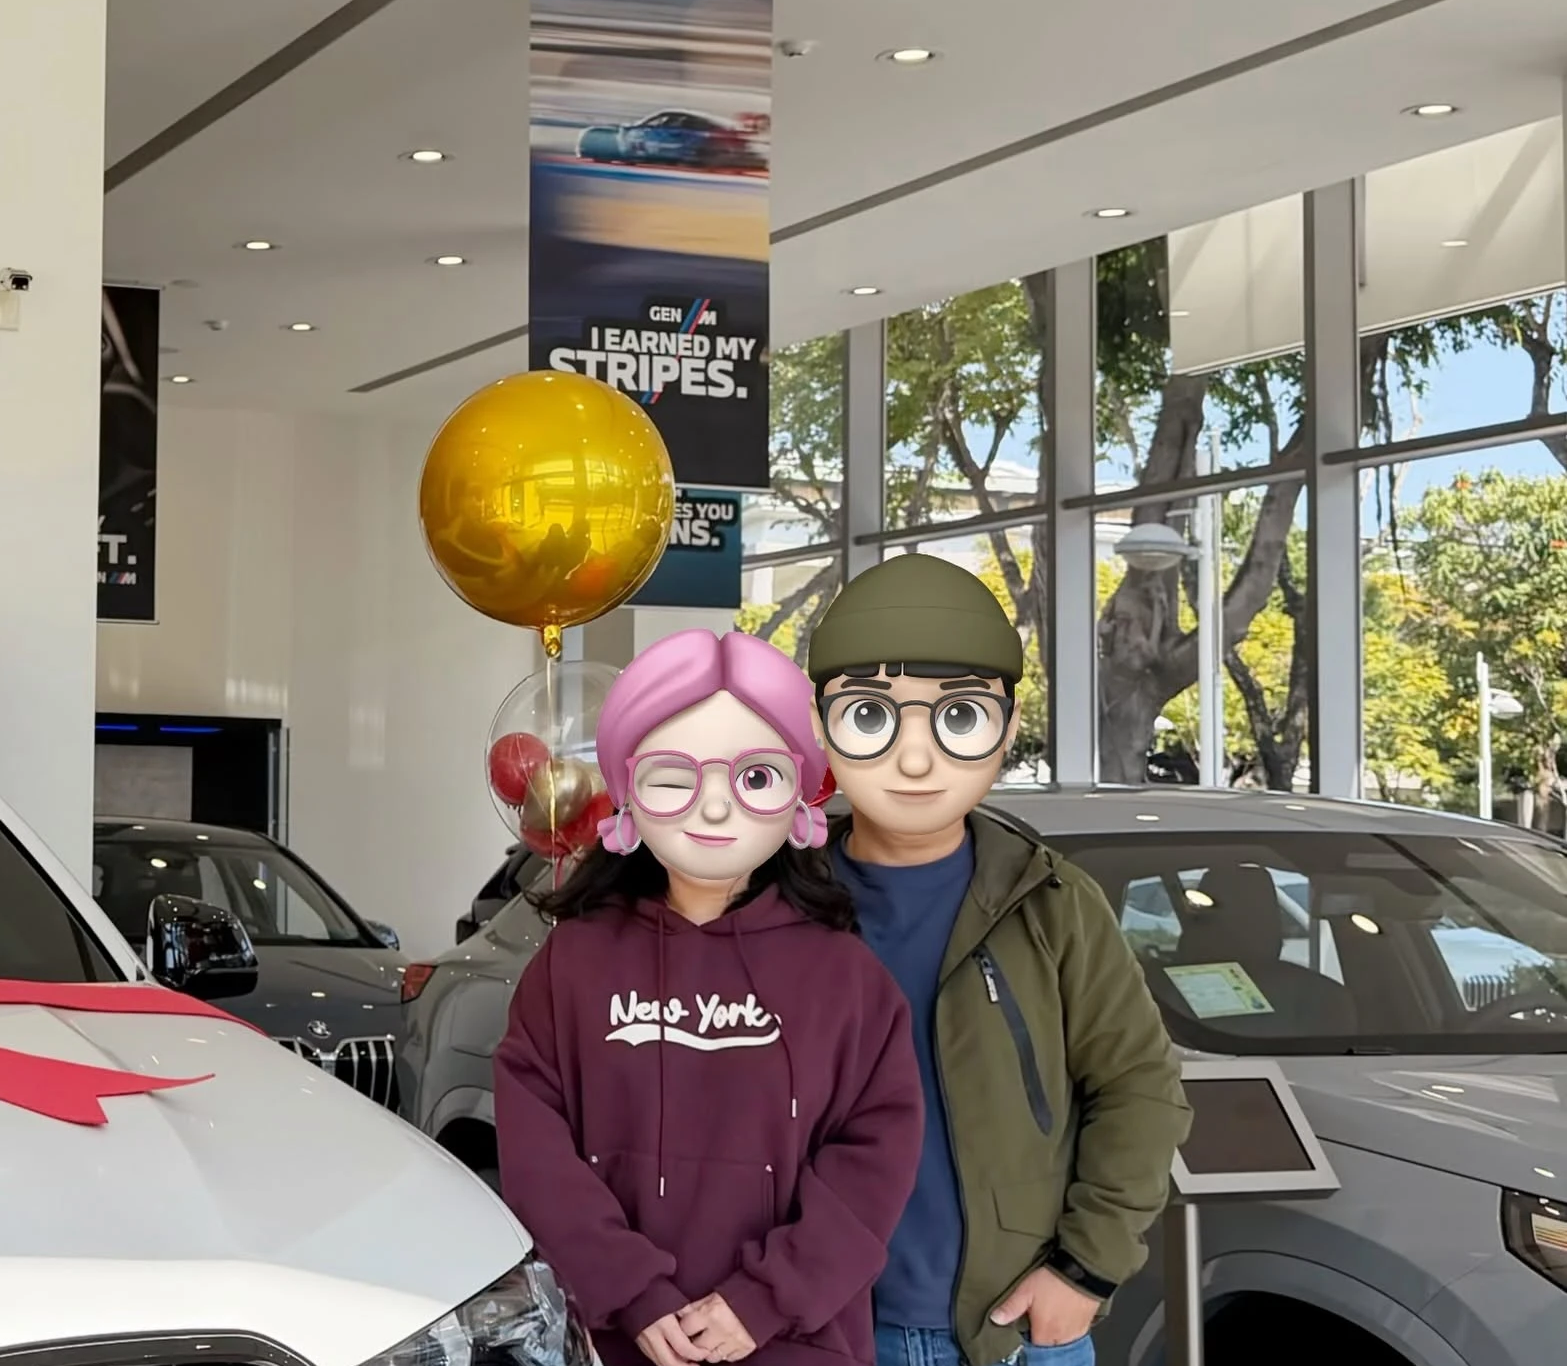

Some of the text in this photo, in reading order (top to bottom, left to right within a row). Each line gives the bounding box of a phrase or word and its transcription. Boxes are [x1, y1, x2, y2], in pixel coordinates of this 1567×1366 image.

[648, 305, 683, 323] GEN
[591, 326, 757, 361] I EARNED MY
[549, 346, 748, 400] STRIPES.
[674, 502, 735, 521] ES YOU
[97, 533, 138, 565] T.
[669, 518, 721, 548] NS.
[610, 990, 773, 1034] New York
